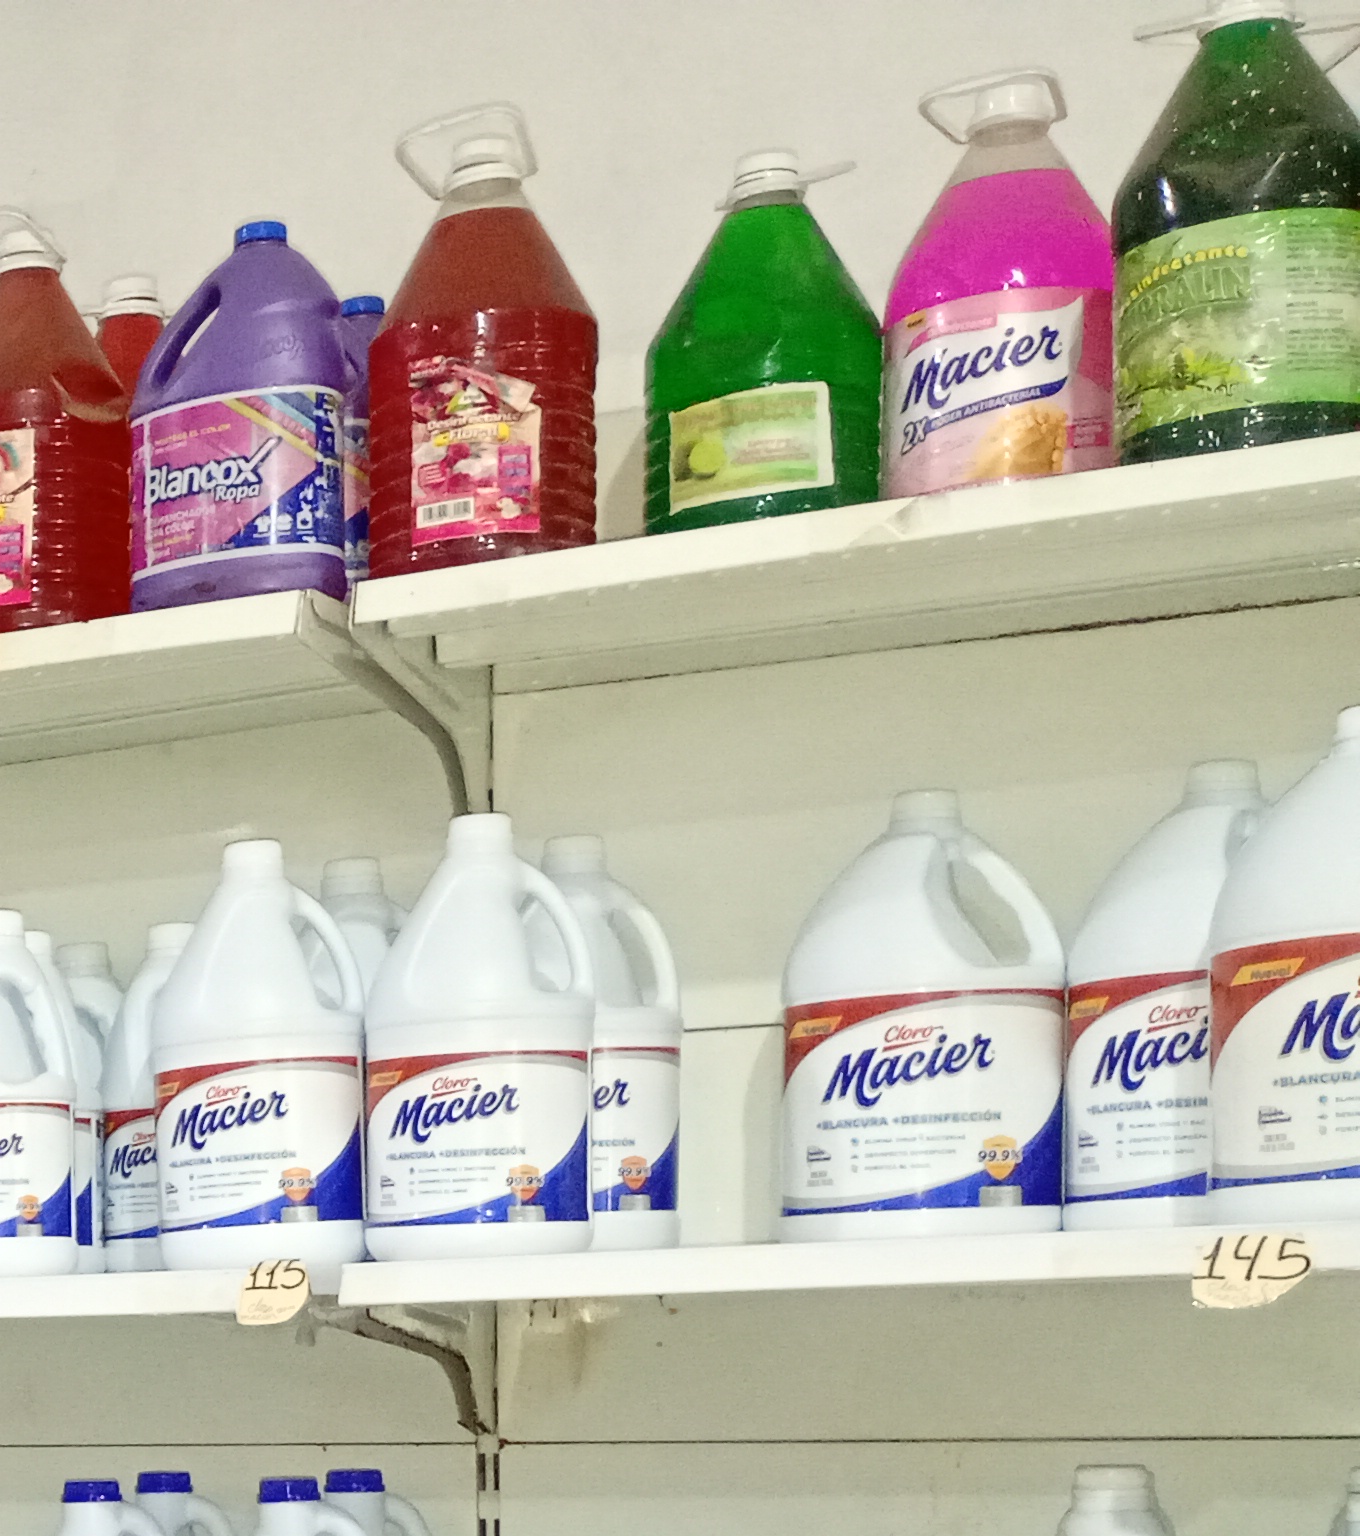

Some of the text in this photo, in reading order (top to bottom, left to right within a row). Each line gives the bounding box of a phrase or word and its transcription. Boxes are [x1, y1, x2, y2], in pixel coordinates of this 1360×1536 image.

[900, 322, 1063, 413] Macier
[900, 416, 929, 456] 2X
[145, 437, 281, 504] Blancox
[214, 482, 261, 504] Ropa
[883, 1024, 944, 1044] Cloro
[1148, 1004, 1208, 1025] Cloro
[821, 1033, 995, 1108] Macier
[1090, 1015, 1209, 1091] Maci
[205, 1084, 248, 1101] Cloro
[431, 1076, 480, 1093] Cloro
[171, 1089, 289, 1151] Macier
[390, 1085, 521, 1143] Macier
[244, 1259, 307, 1292] 115
[1192, 1236, 1312, 1282] 145
